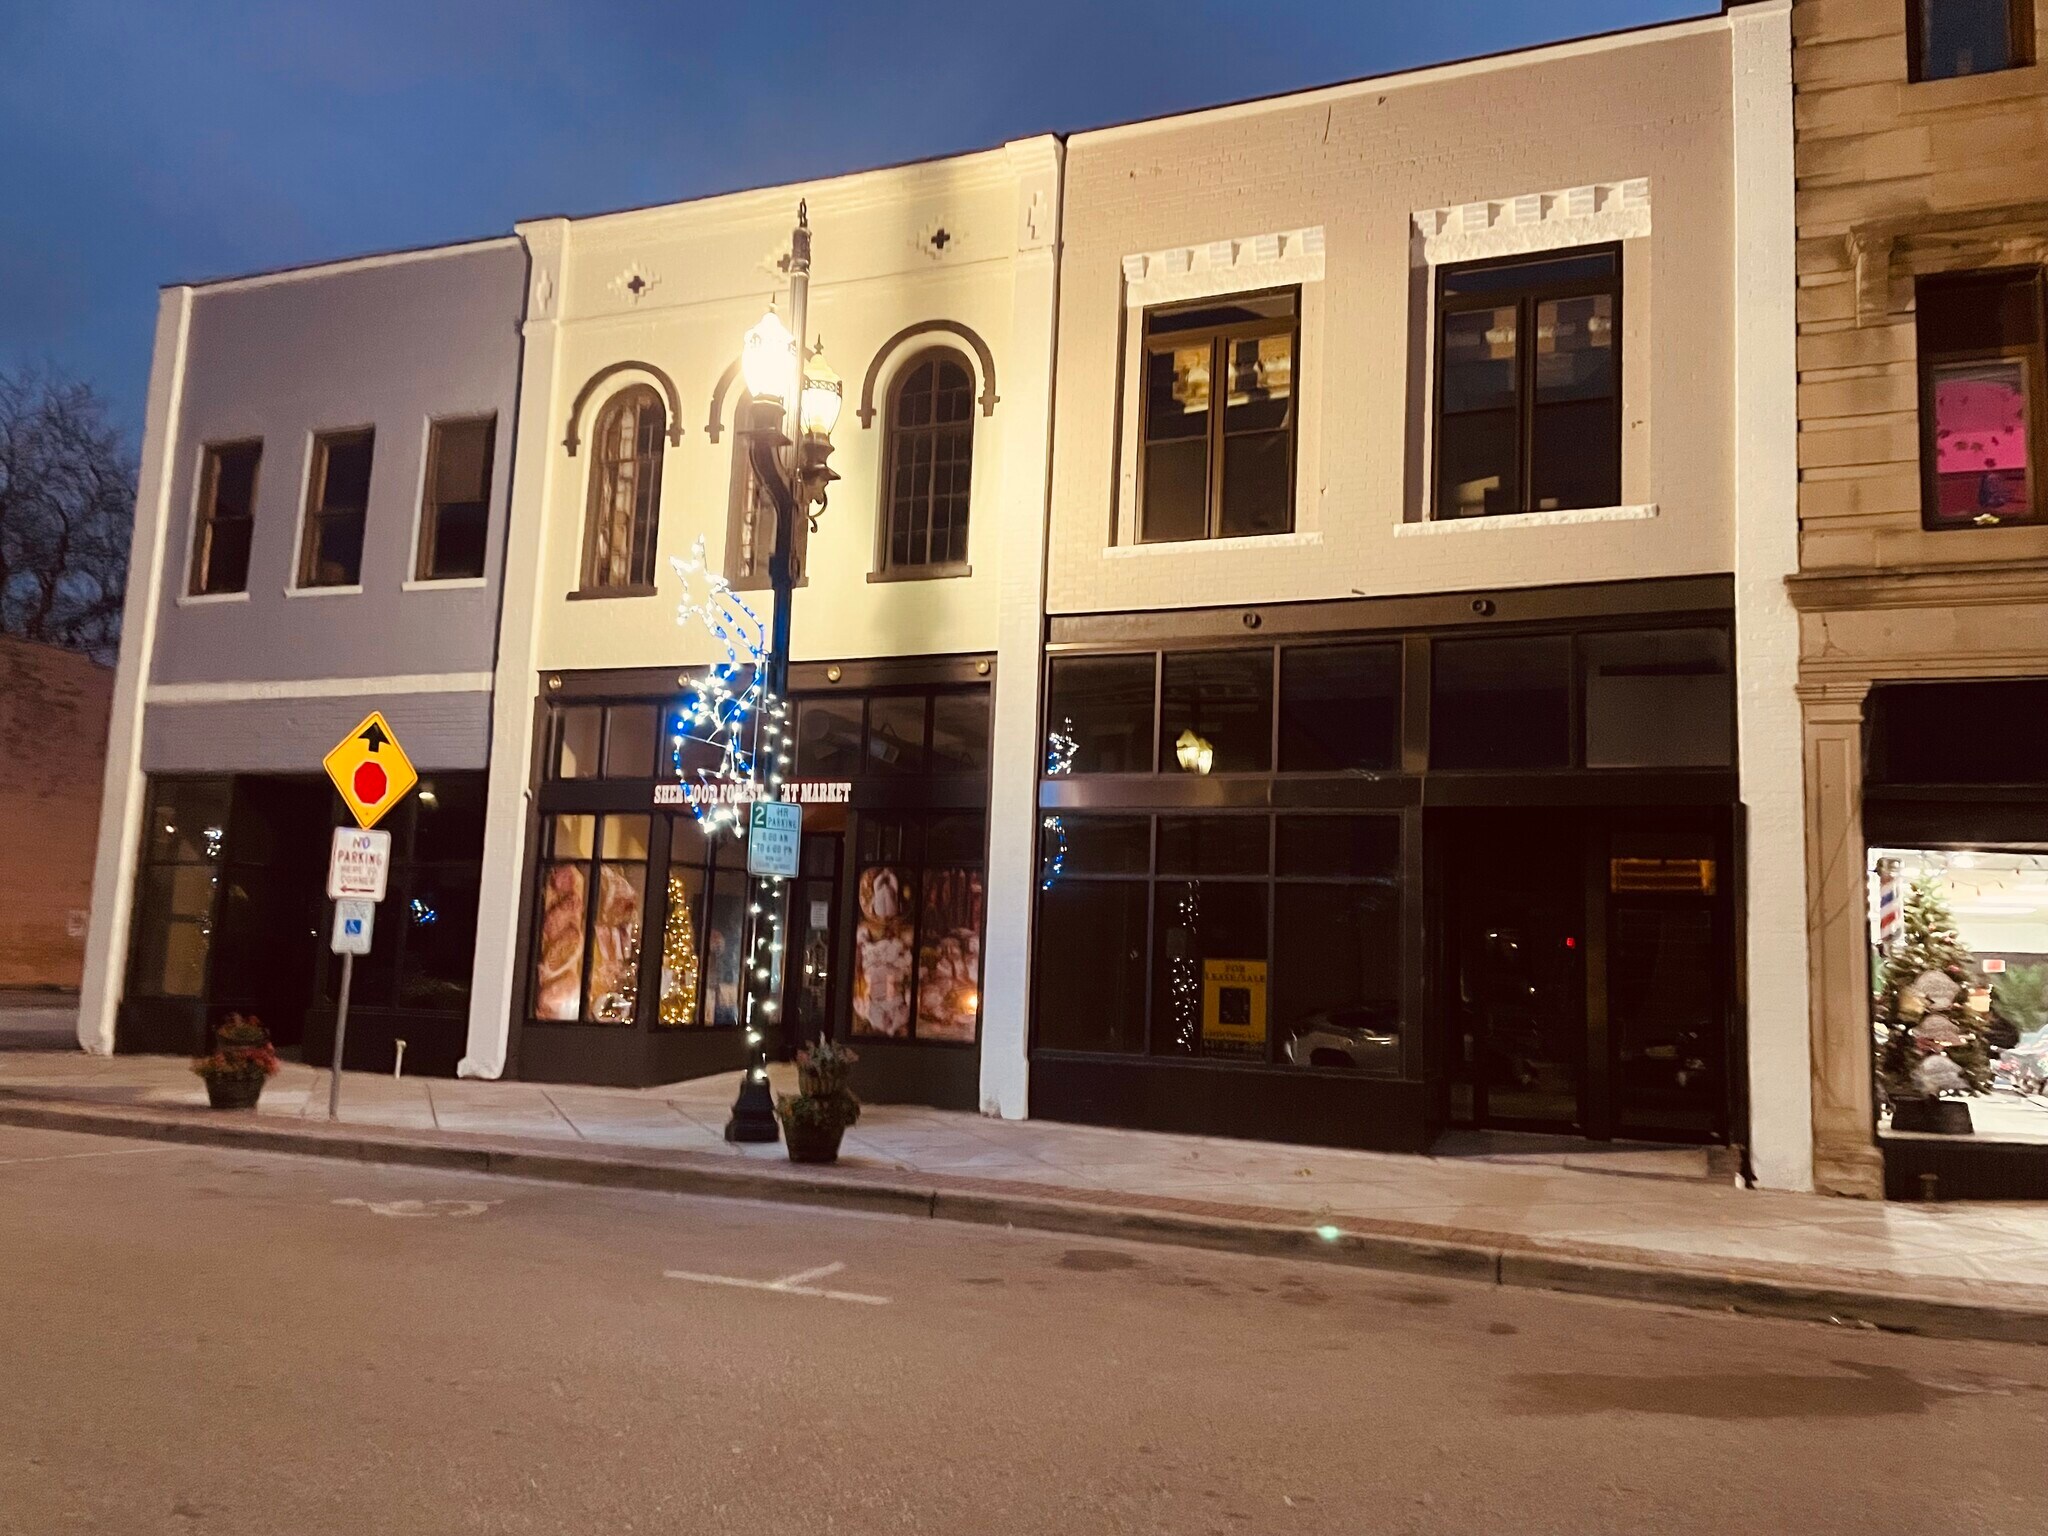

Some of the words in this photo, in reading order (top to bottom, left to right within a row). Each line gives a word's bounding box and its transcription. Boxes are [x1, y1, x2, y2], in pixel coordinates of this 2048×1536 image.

[801, 783, 851, 802] MARKET
[755, 806, 764, 825] 2
[768, 817, 796, 829] PARKING
[352, 837, 371, 849] NO
[337, 850, 383, 866] PARKING
